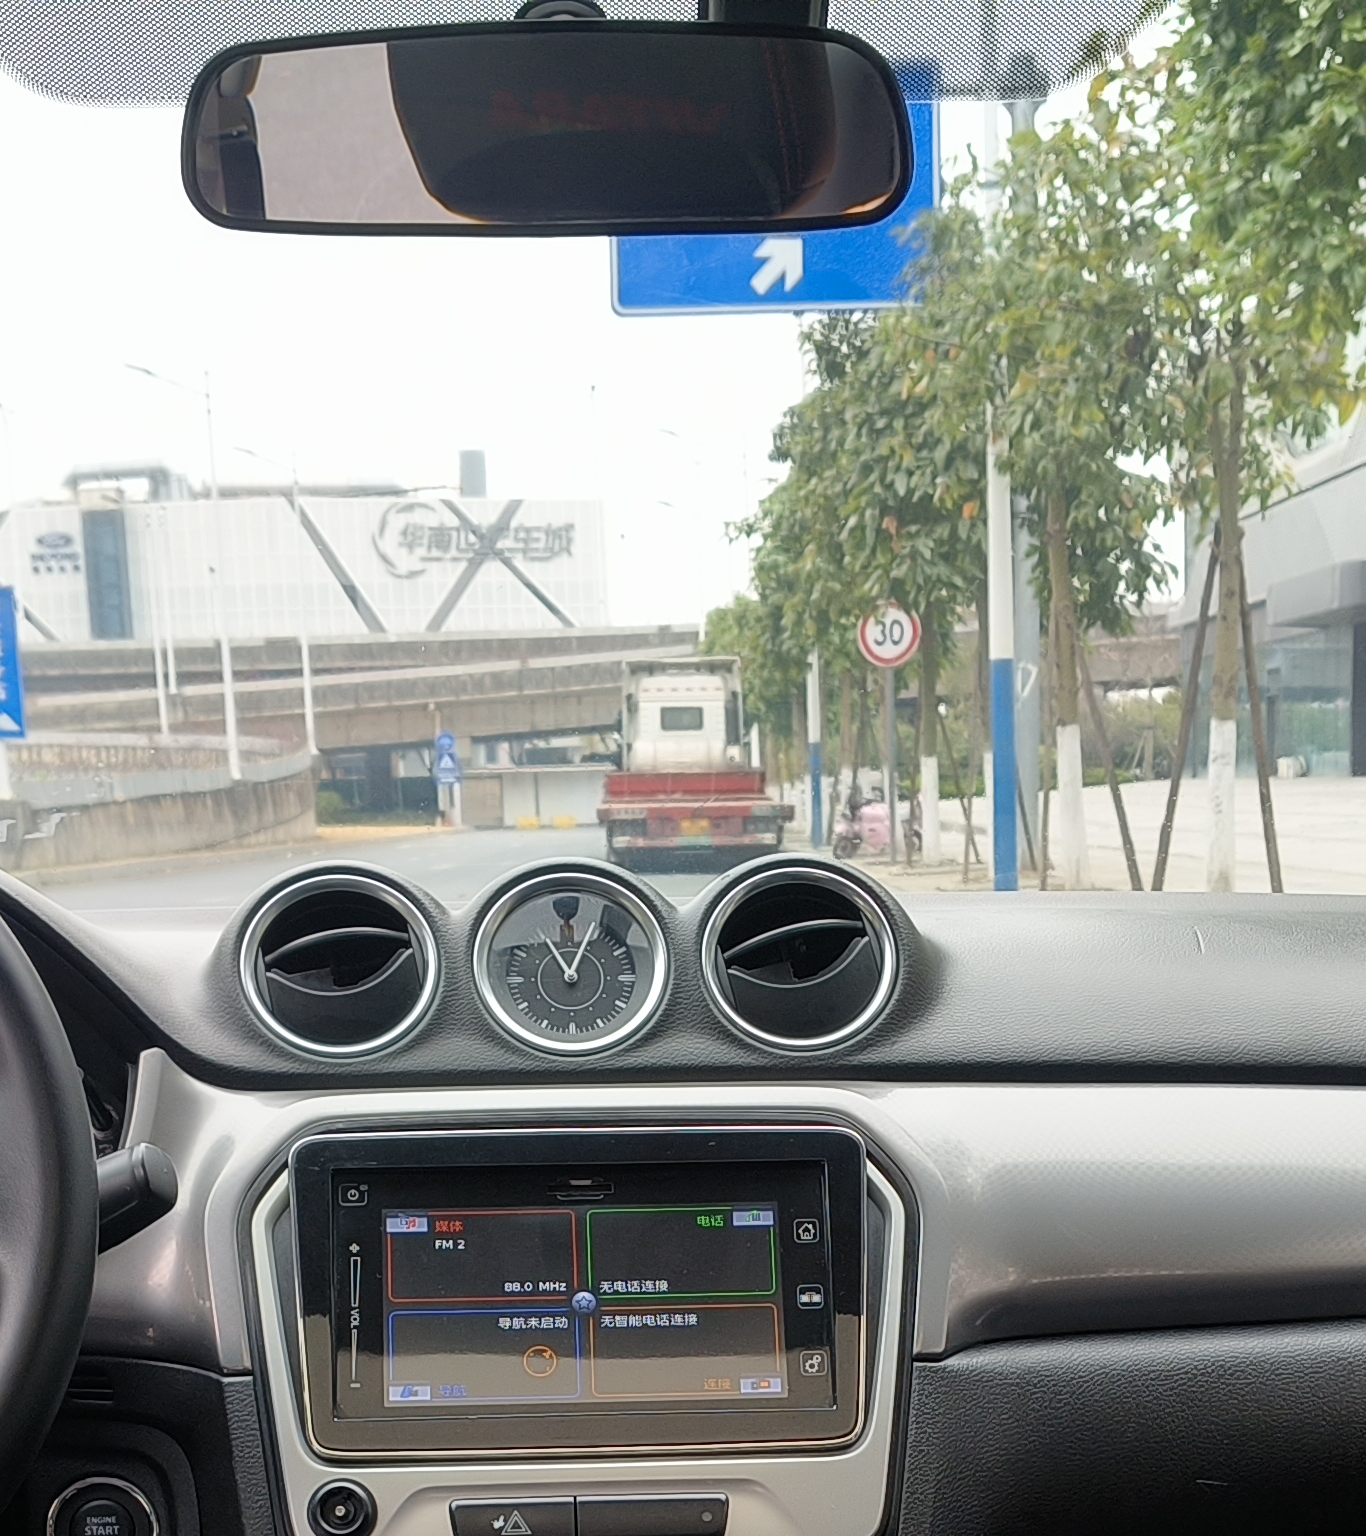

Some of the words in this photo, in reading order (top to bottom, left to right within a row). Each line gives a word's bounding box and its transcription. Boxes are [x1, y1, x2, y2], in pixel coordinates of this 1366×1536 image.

[873, 619, 905, 647] 30
[435, 1220, 464, 1233] 媒体
[696, 1214, 724, 1227] 电话
[434, 1239, 454, 1250] FM
[457, 1239, 466, 1250] 2
[504, 1281, 533, 1292] 88.0
[538, 1281, 567, 1292] MHz
[599, 1279, 669, 1294] 无电话连接
[350, 1308, 360, 1329] VOL
[497, 1316, 569, 1330] 导航未启动
[600, 1313, 698, 1328] 无智能电话连接
[438, 1384, 467, 1397] 导航
[86, 1515, 117, 1524] ENGINE
[84, 1525, 120, 1536] START
